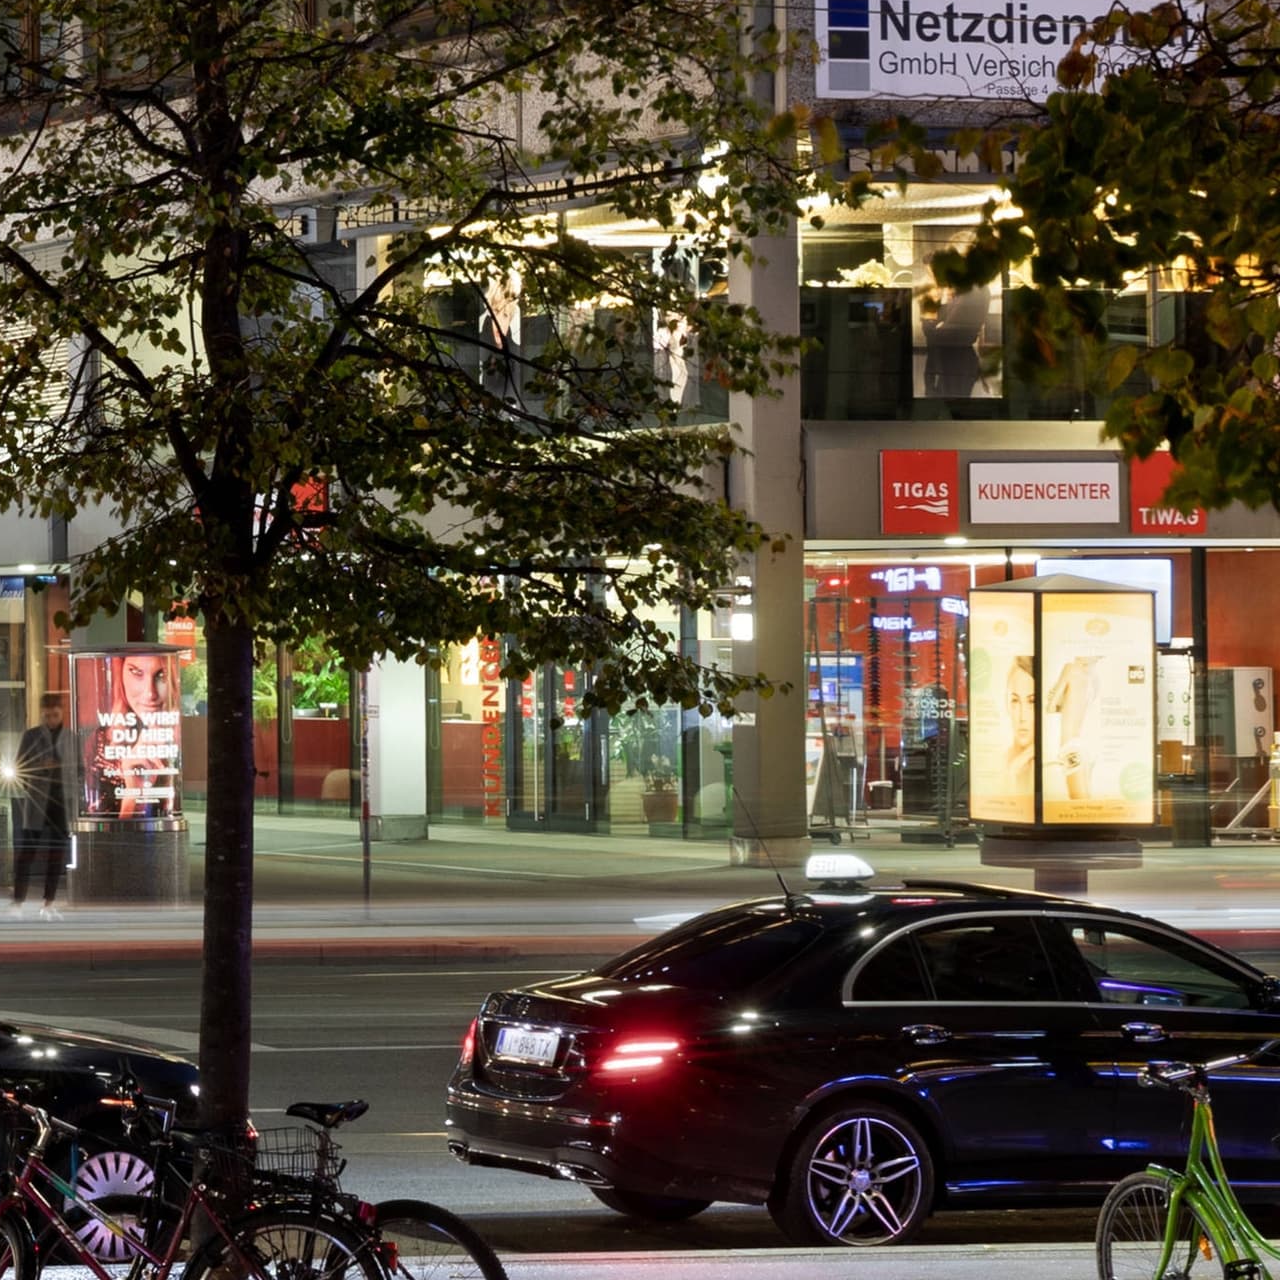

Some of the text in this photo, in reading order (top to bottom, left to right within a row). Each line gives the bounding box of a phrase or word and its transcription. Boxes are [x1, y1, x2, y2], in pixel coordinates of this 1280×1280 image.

[878, 51, 956, 75] GmbH
[892, 482, 948, 497] TIGAS
[978, 483, 1110, 500] KUNDENCENTER
[1139, 508, 1199, 525] TIWAG
[99, 713, 137, 726] WAS
[112, 729, 137, 742] DU
